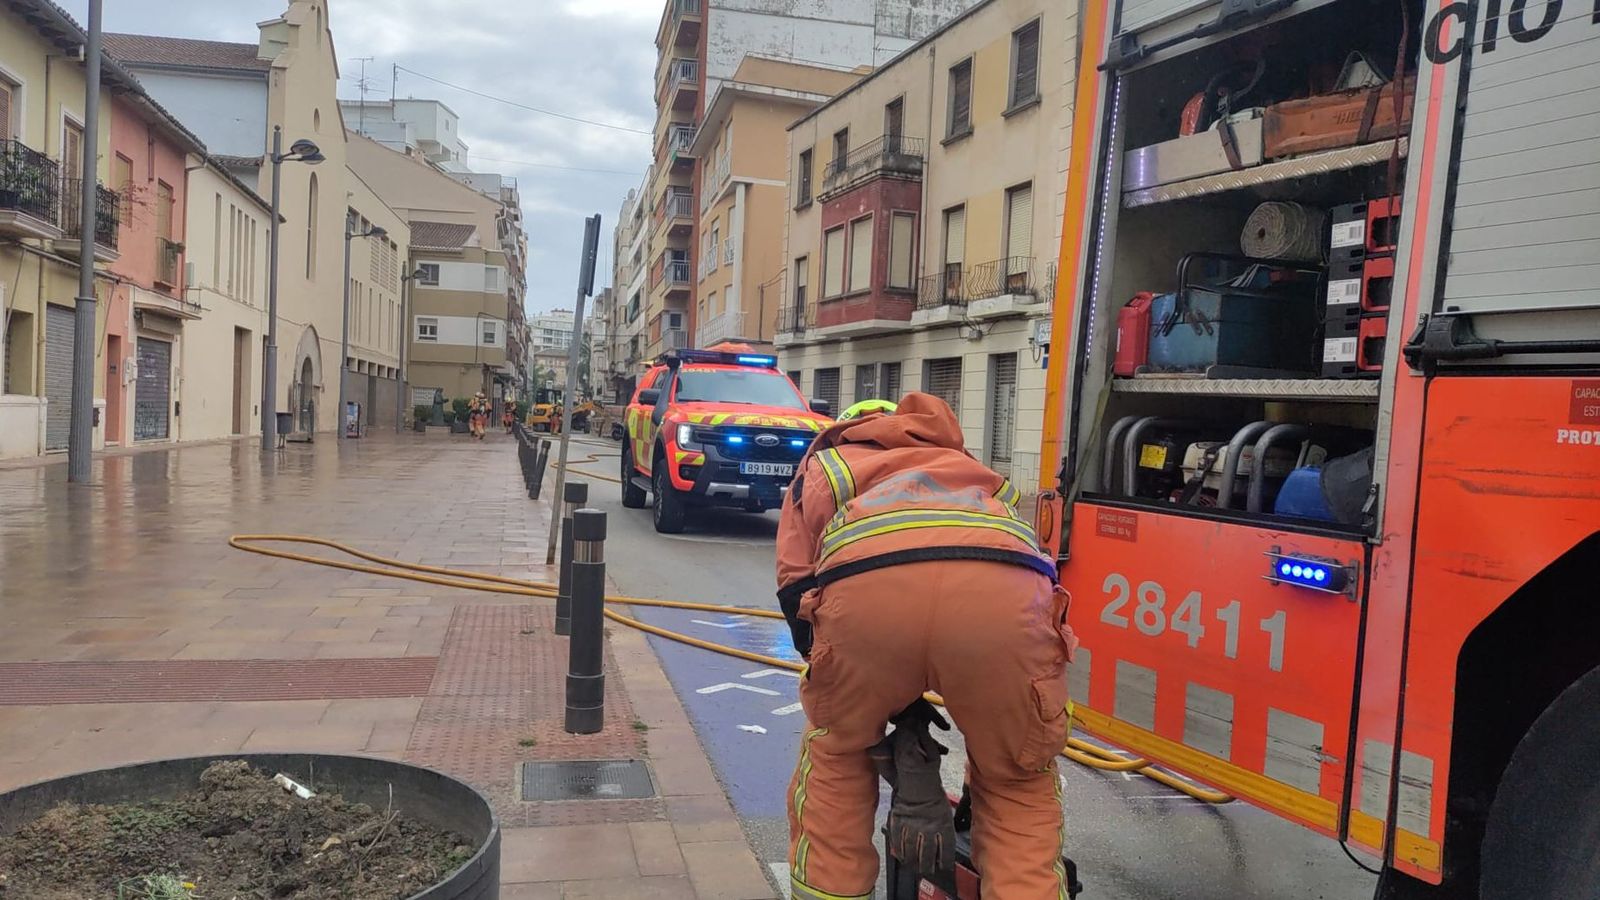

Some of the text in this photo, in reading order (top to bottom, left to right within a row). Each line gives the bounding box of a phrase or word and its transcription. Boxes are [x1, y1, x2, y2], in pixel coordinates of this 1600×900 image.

[747, 463, 792, 475] 8919 MVZ
[1100, 572, 1287, 672] 28411
